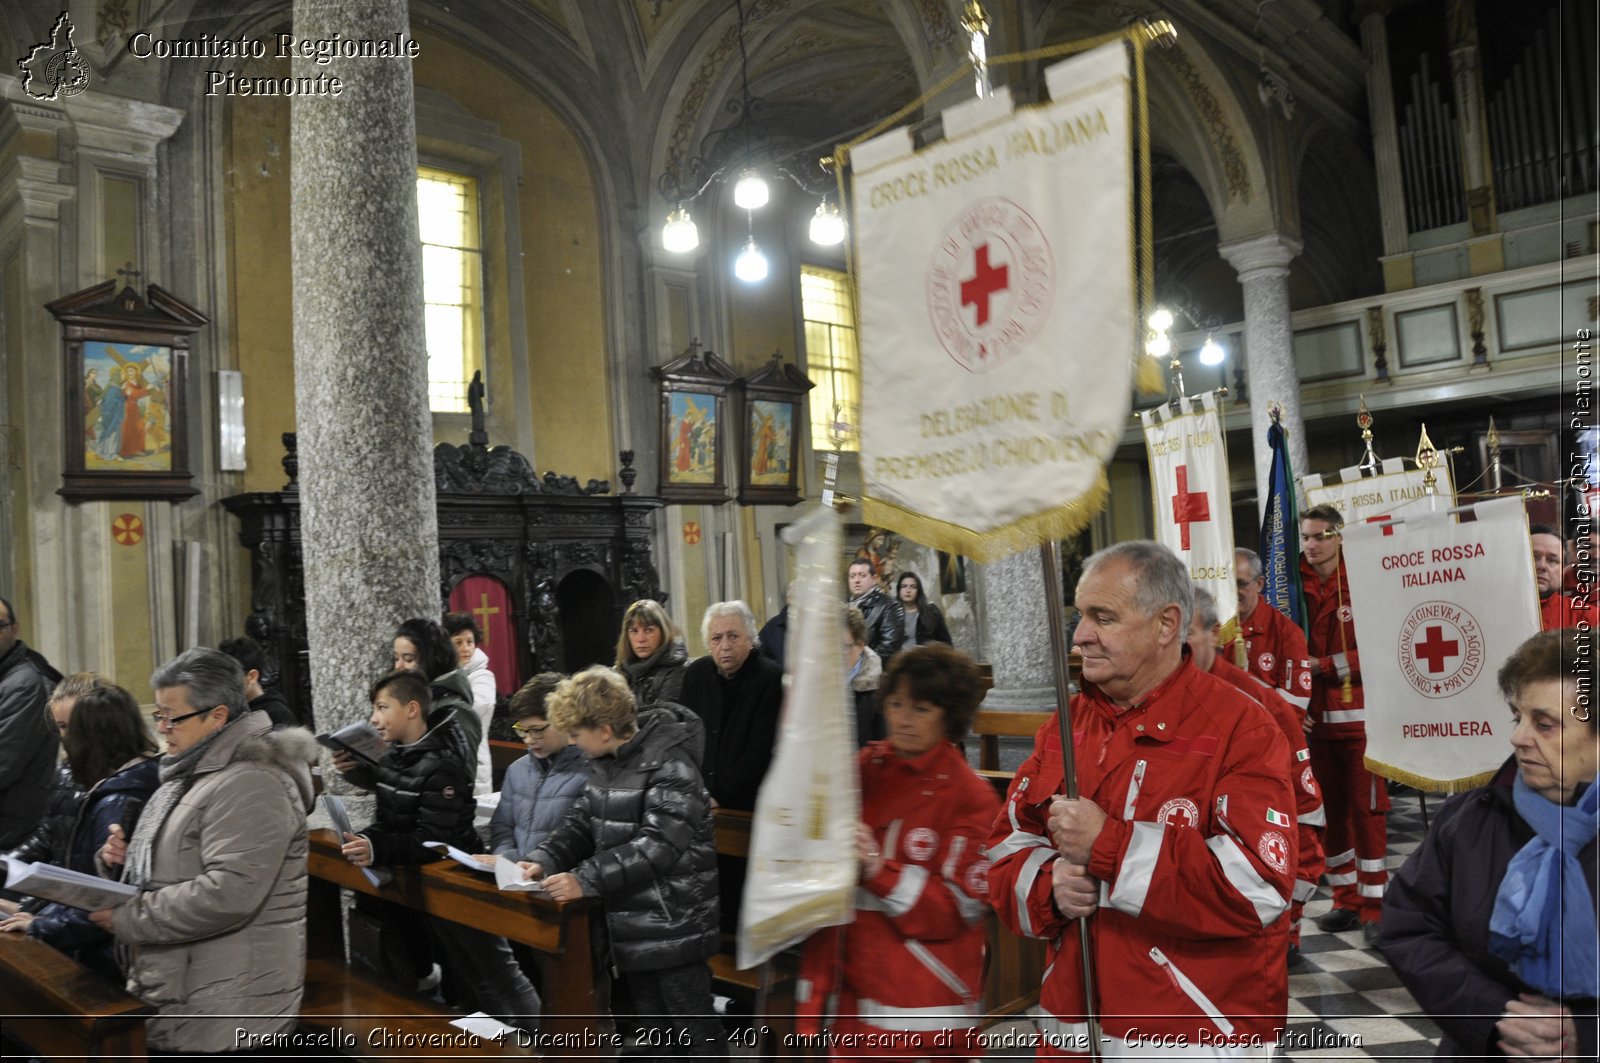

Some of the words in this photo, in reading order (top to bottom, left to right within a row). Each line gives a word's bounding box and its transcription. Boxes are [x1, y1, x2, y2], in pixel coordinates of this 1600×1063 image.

[870, 168, 928, 209] CROCE
[932, 144, 999, 188] ROSSA
[1352, 492, 1384, 508] ROSSA
[1273, 493, 1283, 534] VERBANIA
[1274, 537, 1285, 545] DI
[1382, 551, 1425, 570] CROCE
[1431, 543, 1485, 563] ROSSA
[1402, 567, 1466, 588] ITALIANA
[1407, 616, 1417, 629] DI
[1415, 605, 1461, 624] GINEVRA
[1461, 620, 1475, 634] 22
[1401, 628, 1432, 693] CONVENZIONE
[1462, 633, 1481, 678] AGOSTO
[1444, 675, 1466, 692] 1864
[1402, 721, 1493, 739] PIEDIMULERA
